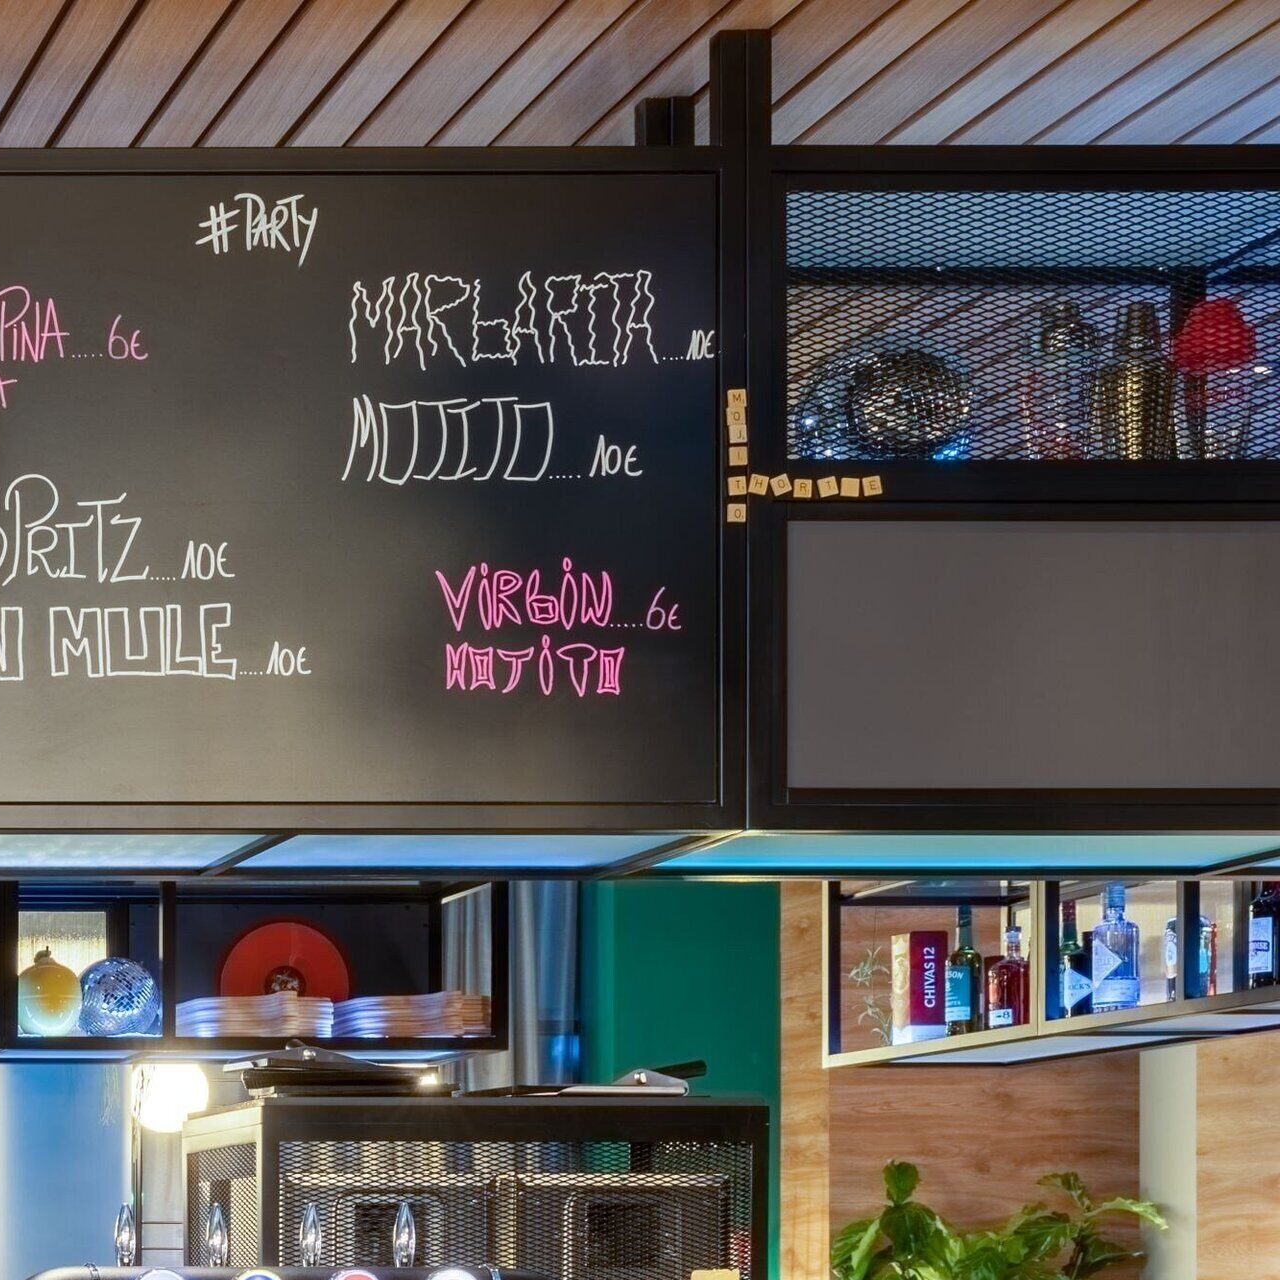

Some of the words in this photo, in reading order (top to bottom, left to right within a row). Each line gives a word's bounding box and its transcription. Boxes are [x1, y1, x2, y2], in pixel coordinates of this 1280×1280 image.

[195, 191, 319, 268] #PARTY
[49, 602, 236, 681] MULE
[923, 946, 936, 961] 12
[923, 961, 937, 1009] CHIVAS
